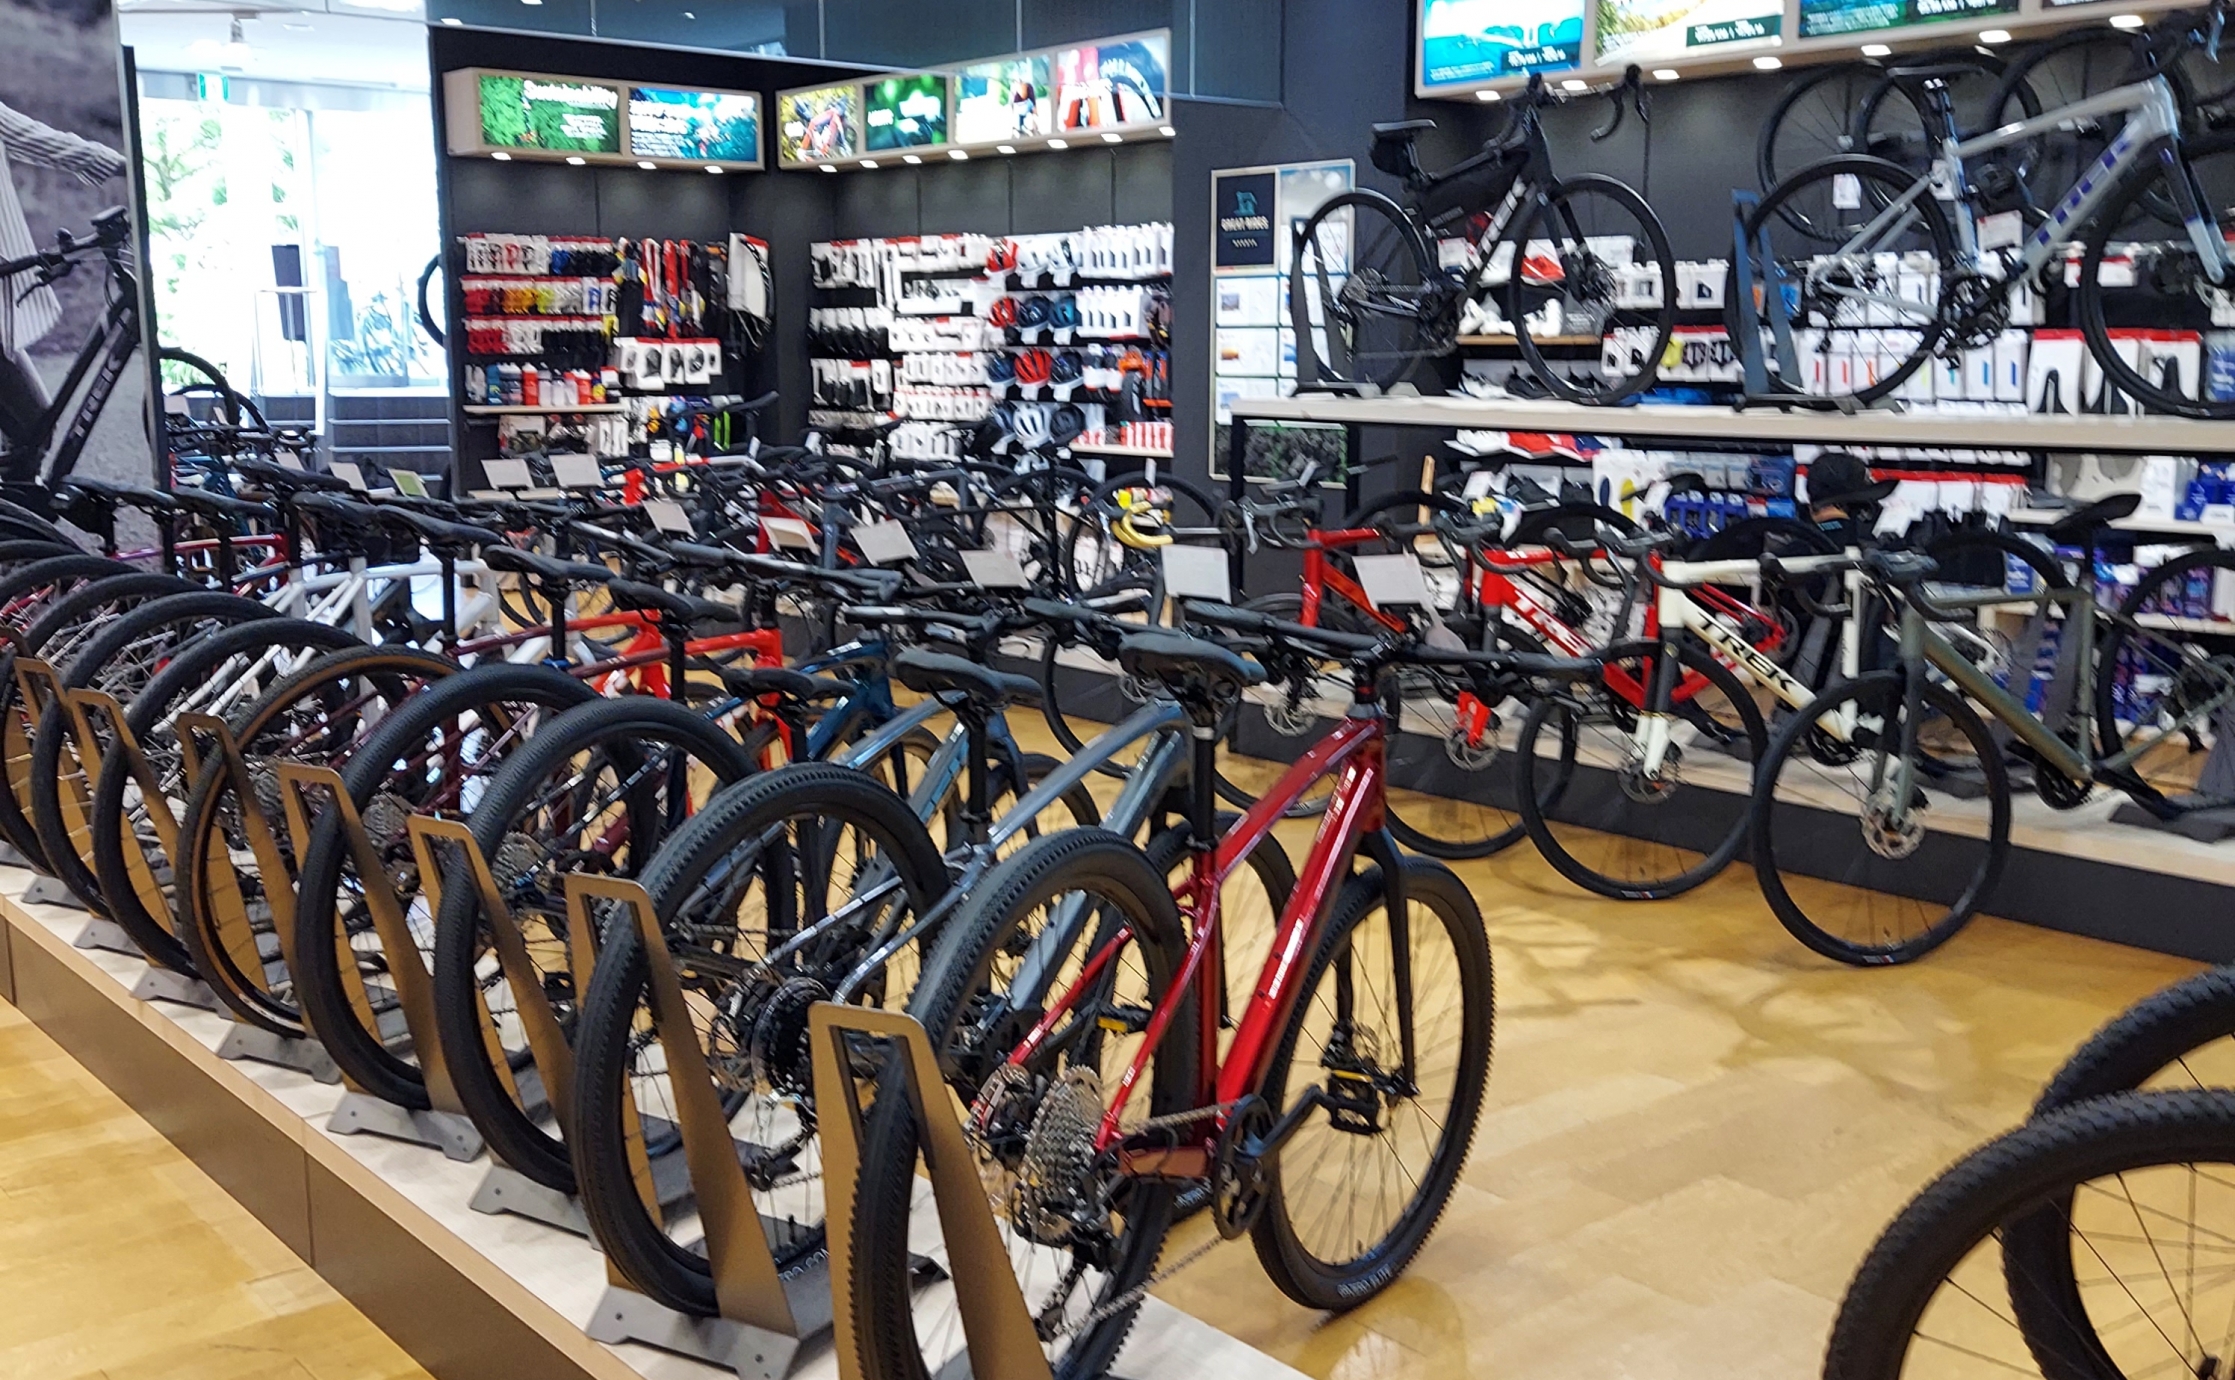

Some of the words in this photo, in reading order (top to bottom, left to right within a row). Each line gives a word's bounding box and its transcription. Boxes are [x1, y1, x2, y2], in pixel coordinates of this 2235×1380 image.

[67, 352, 122, 440] TREK
[1514, 589, 1592, 658] TRE
[1698, 610, 1796, 695] TREK
